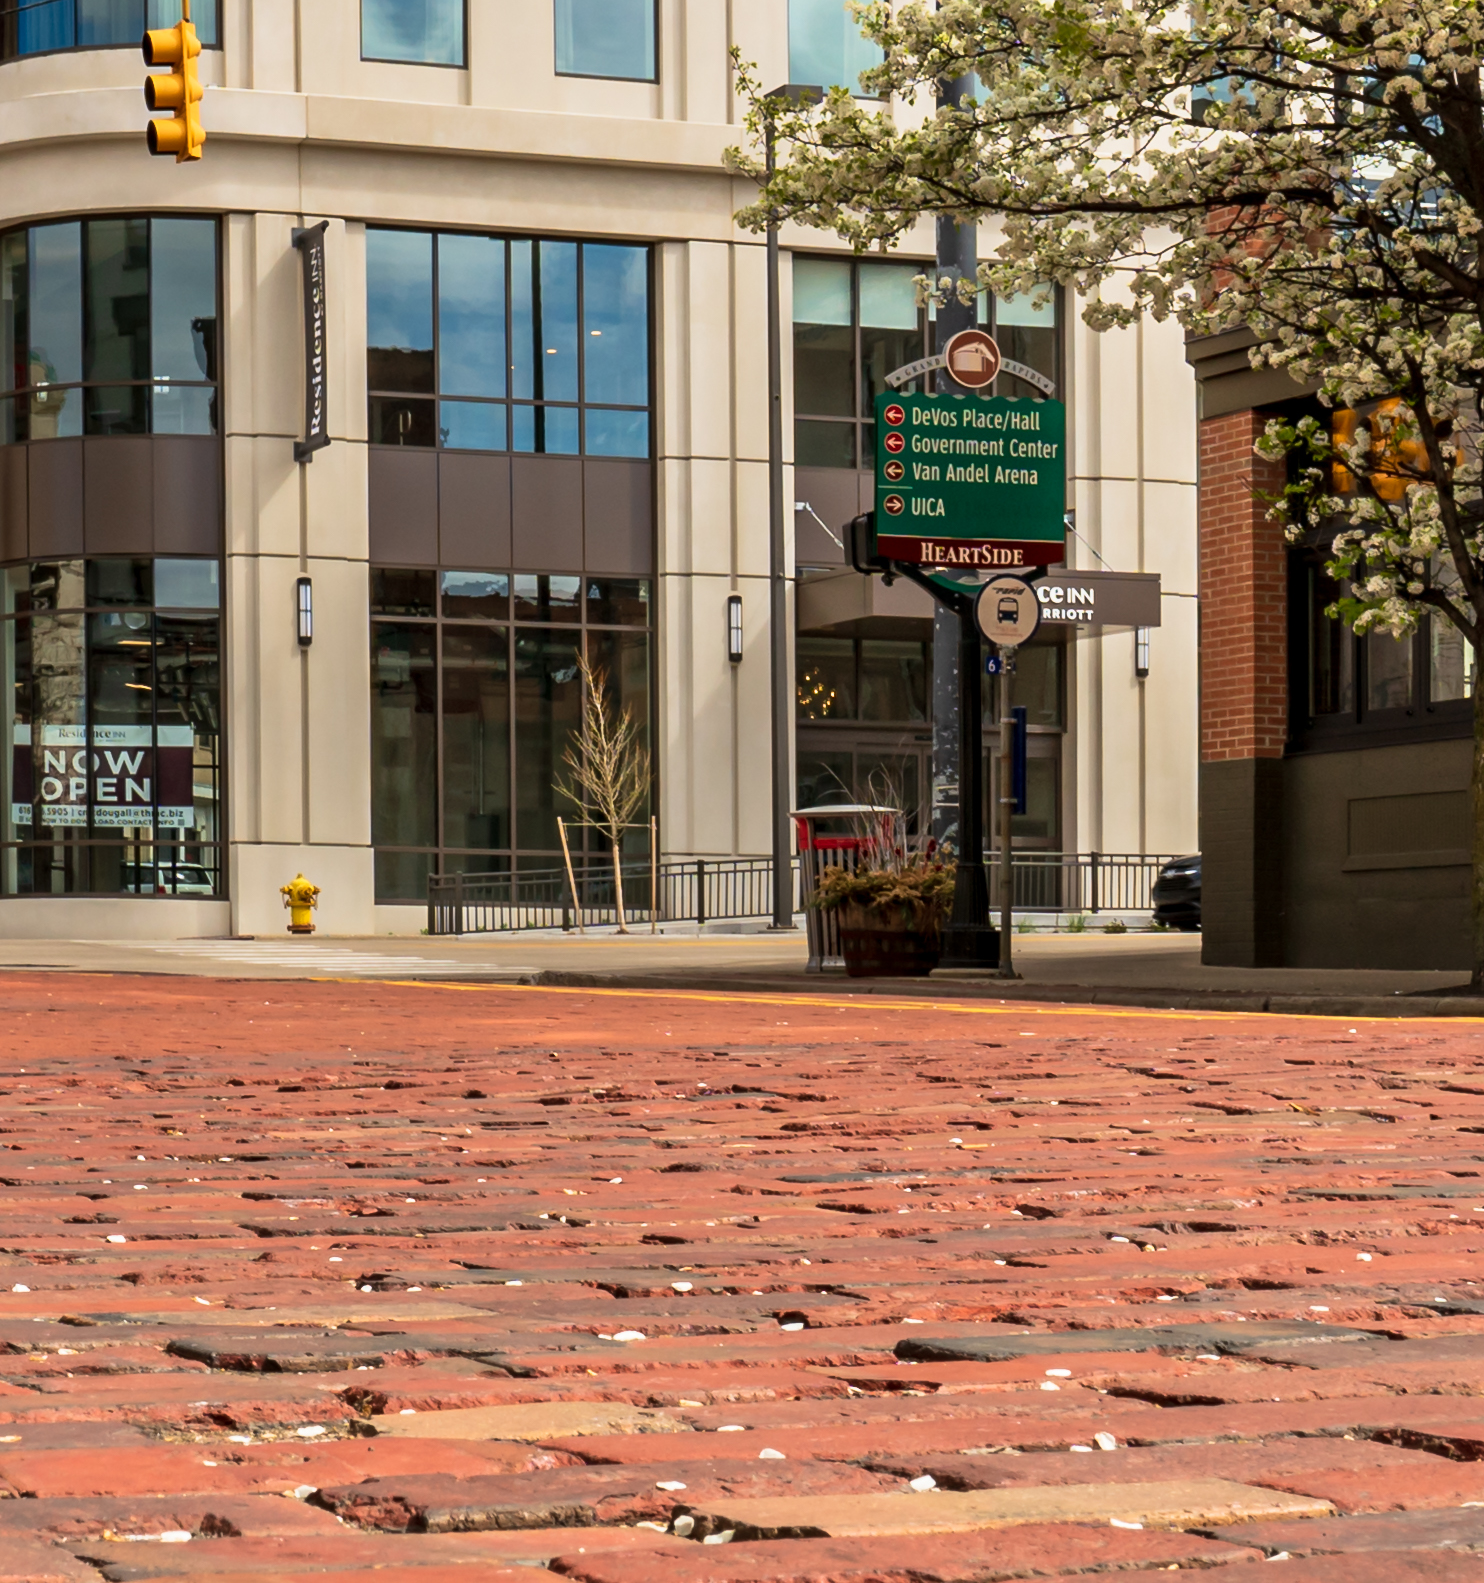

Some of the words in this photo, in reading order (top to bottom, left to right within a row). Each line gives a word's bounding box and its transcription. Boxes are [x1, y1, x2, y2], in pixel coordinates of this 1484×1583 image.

[311, 287, 322, 436] Residence
[905, 358, 940, 376] GRAND
[1005, 361, 1041, 383] RAPIDS
[912, 407, 957, 426] DeVos
[963, 409, 1040, 431] Place/Hall
[911, 434, 1004, 457] Government
[1009, 439, 1058, 459] Center
[912, 462, 940, 482] Van
[946, 463, 989, 483] Andel
[995, 465, 1038, 485] Arena
[911, 497, 945, 517] UICA
[1067, 587, 1094, 605] INN
[1042, 608, 1094, 621] RRIOTT
[988, 659, 996, 672] 6
[58, 728, 111, 738] Residnce
[43, 749, 145, 775] NOW
[41, 777, 151, 802] OPEN
